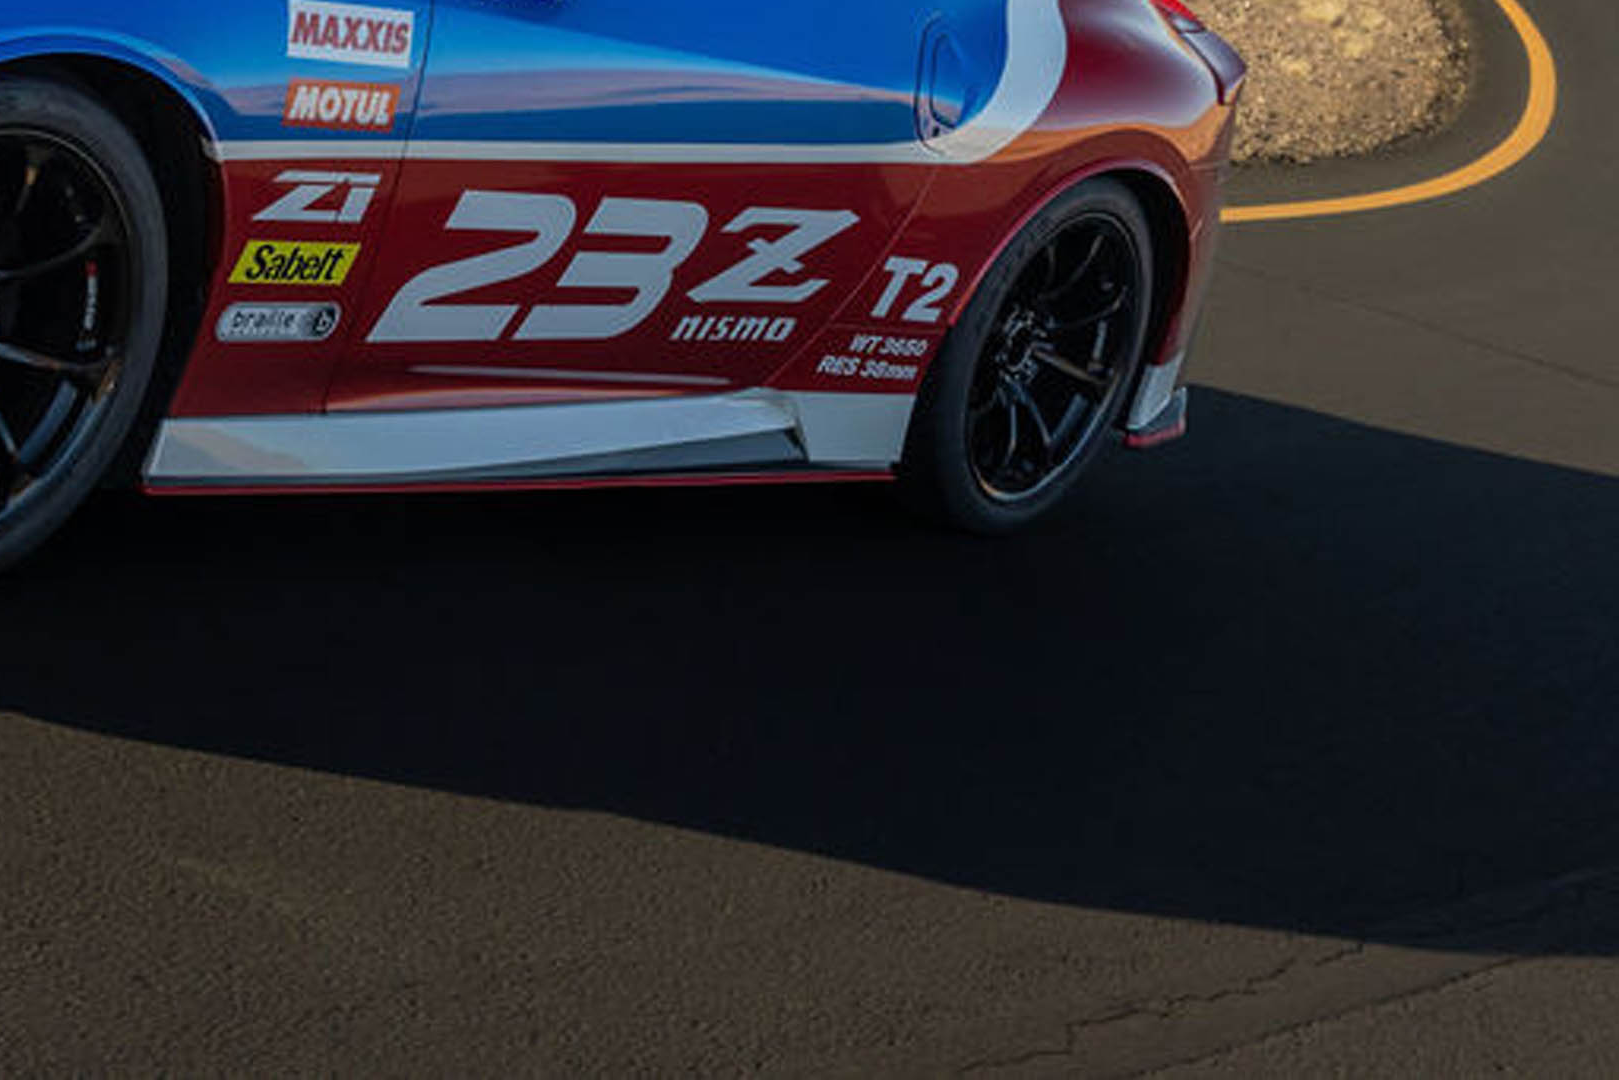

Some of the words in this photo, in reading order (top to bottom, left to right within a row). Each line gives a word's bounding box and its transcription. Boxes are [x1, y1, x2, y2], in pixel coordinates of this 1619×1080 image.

[291, 11, 409, 55] MAXXIS
[288, 85, 392, 126] MOTUL
[245, 244, 344, 281] Sabelt
[870, 253, 959, 323] T2
[849, 334, 882, 354] WT
[816, 354, 861, 376] RES
